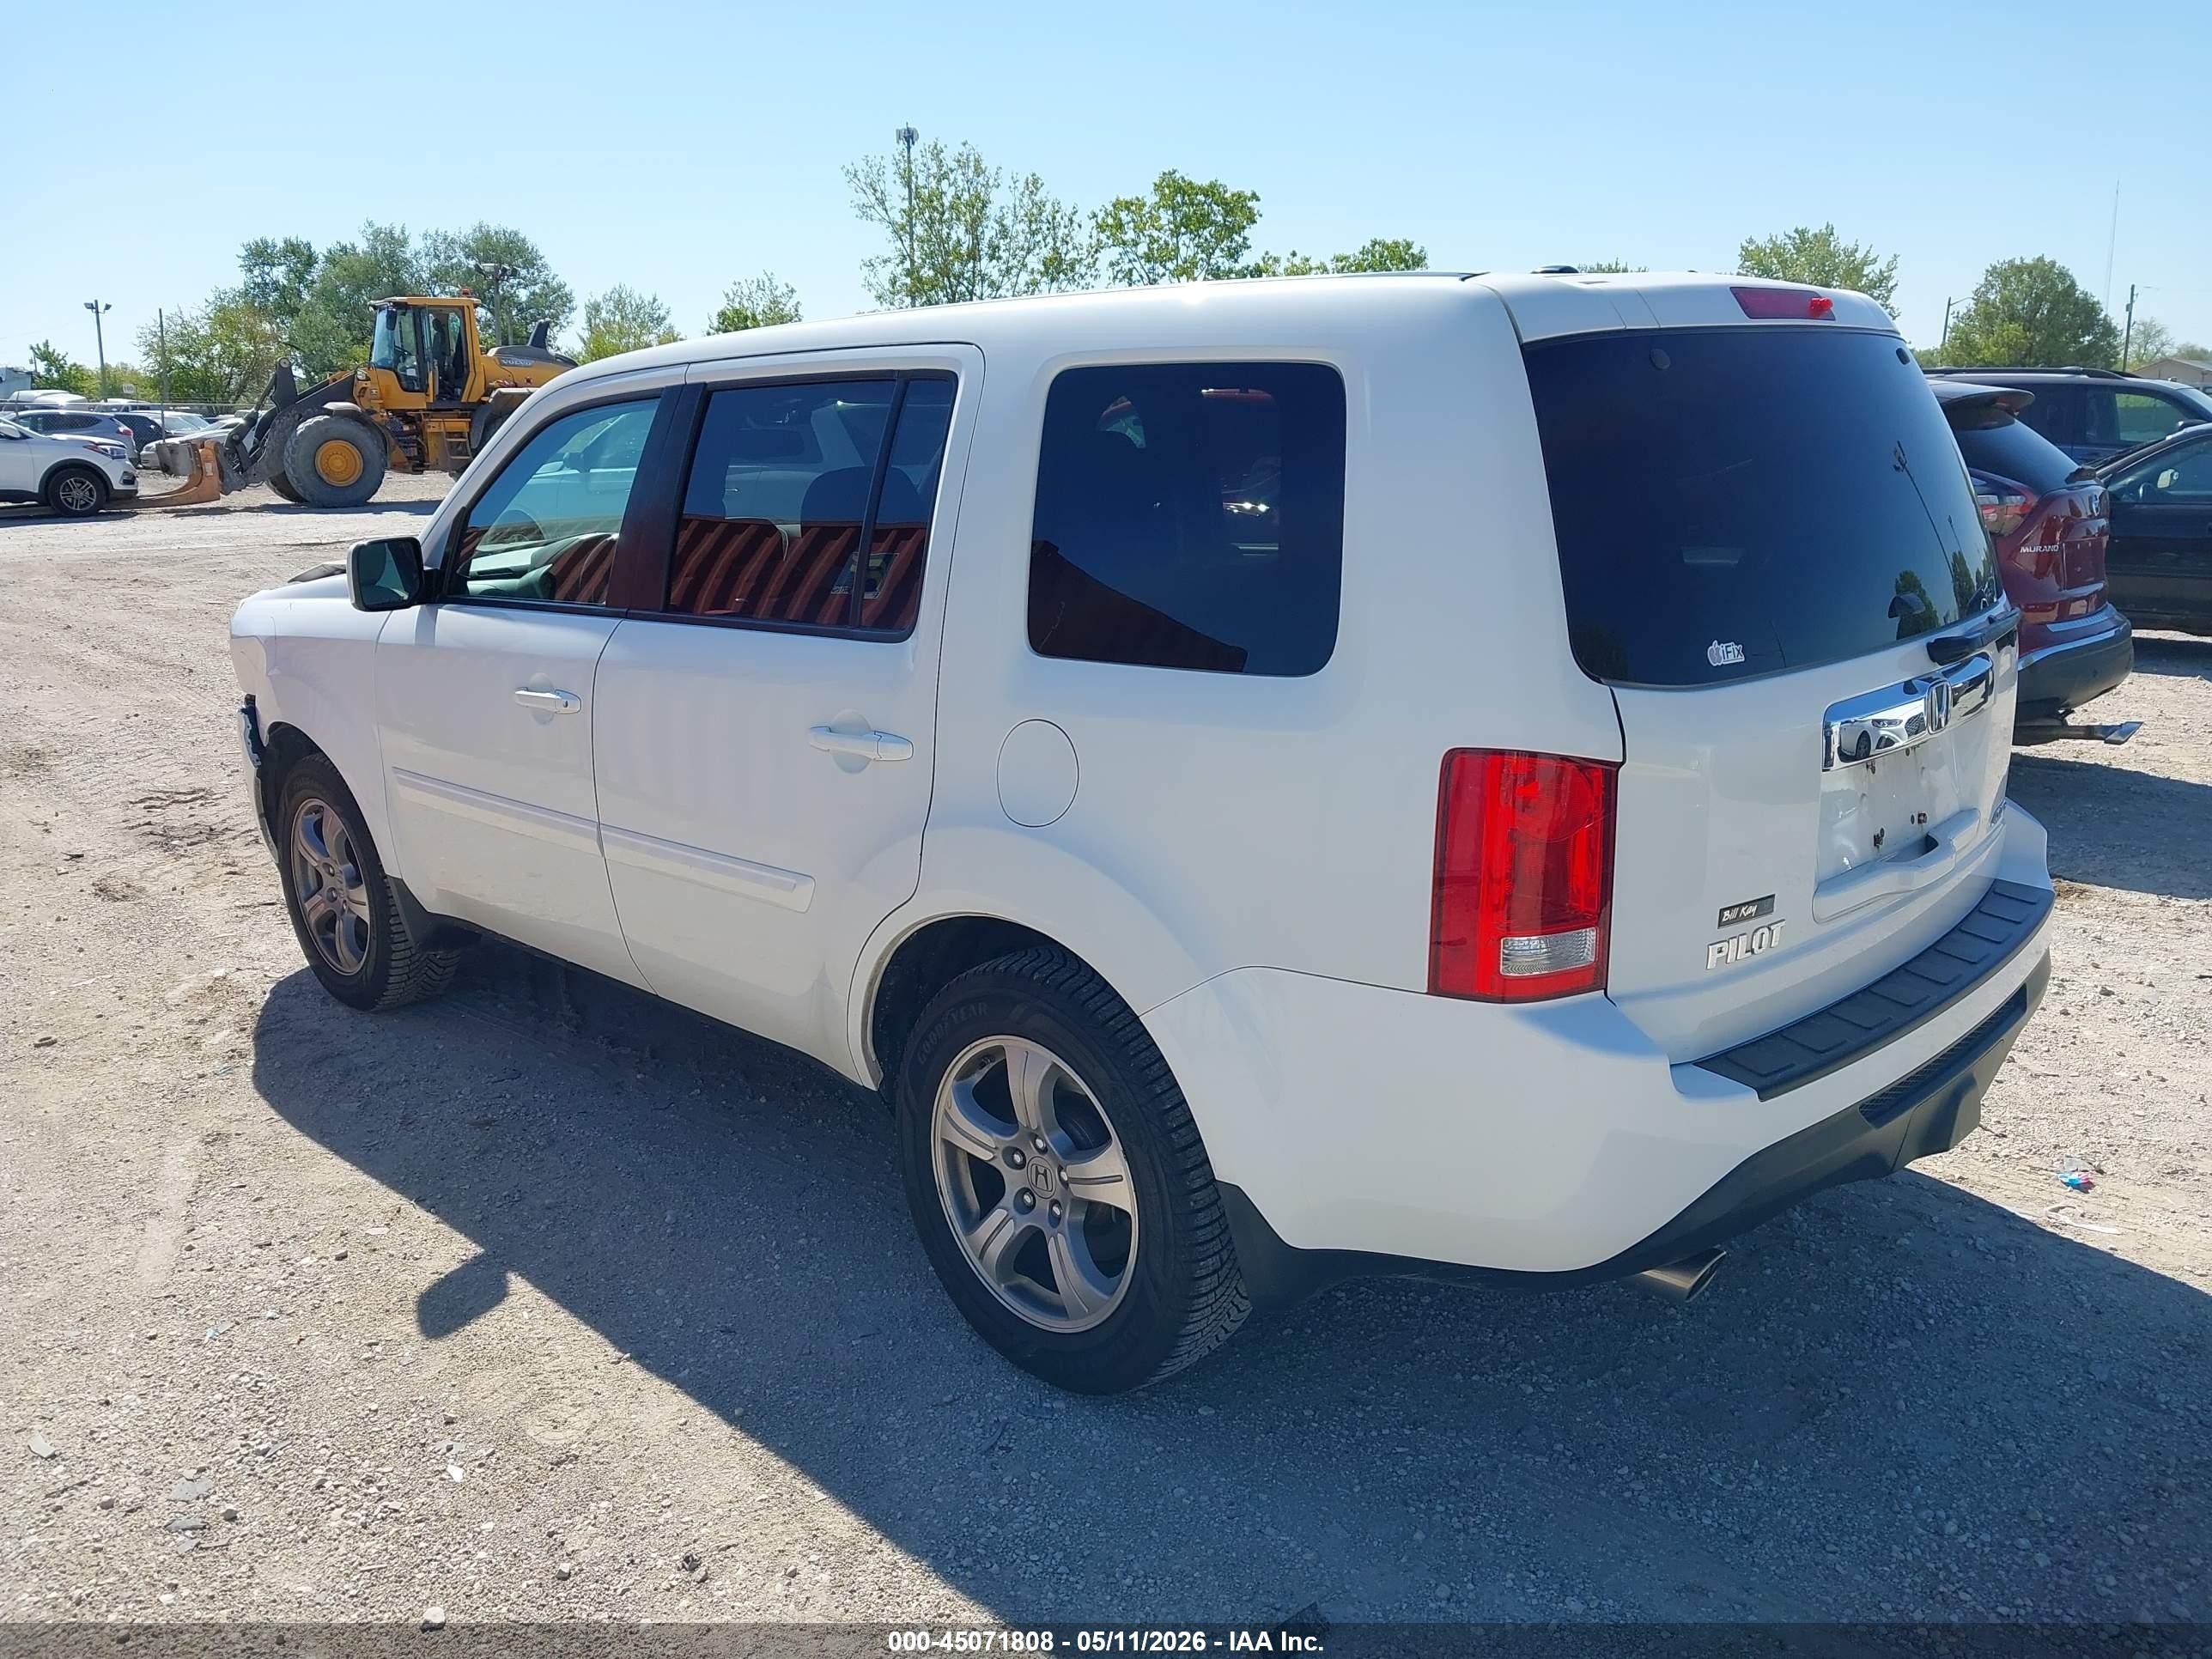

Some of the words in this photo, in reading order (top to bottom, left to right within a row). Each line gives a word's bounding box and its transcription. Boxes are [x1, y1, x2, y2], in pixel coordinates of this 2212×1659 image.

[2020, 544, 2059, 553] MURANO
[1720, 643, 1744, 661] iFix
[1723, 908, 1739, 921] Bill
[1740, 904, 1758, 917] Kay
[1706, 919, 1786, 969] PILOT
